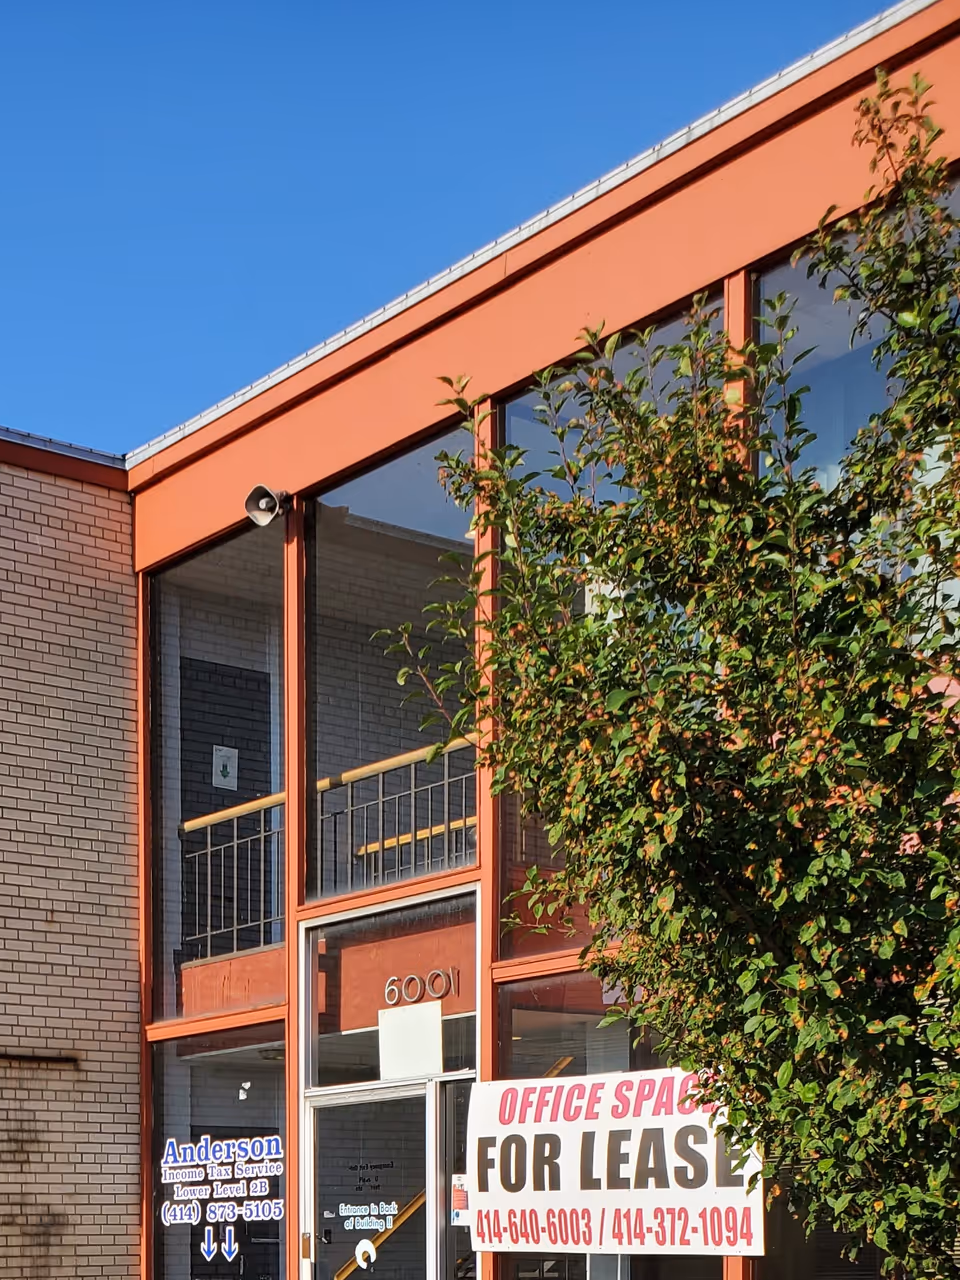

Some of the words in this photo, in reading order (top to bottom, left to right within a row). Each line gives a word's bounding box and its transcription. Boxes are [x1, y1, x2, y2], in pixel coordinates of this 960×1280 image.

[384, 967, 459, 1005] 6001
[498, 1082, 606, 1125] OFFICE
[162, 1136, 283, 1166] Anderson
[477, 1133, 561, 1193] FOR
[162, 1168, 204, 1182] Income
[208, 1165, 231, 1180] Tax
[235, 1161, 283, 1177] Service
[175, 1185, 210, 1199] Lower
[214, 1181, 246, 1197] Level
[251, 1180, 268, 1195] 2B
[162, 1201, 201, 1225] (414)
[207, 1200, 283, 1221] 873-5105
[340, 1203, 369, 1215] Entrance
[380, 1202, 397, 1213] Back
[344, 1218, 354, 1230] of
[355, 1218, 384, 1231] Building
[476, 1207, 593, 1246] 414-640-6003
[612, 1206, 754, 1247] 414-372-1094
